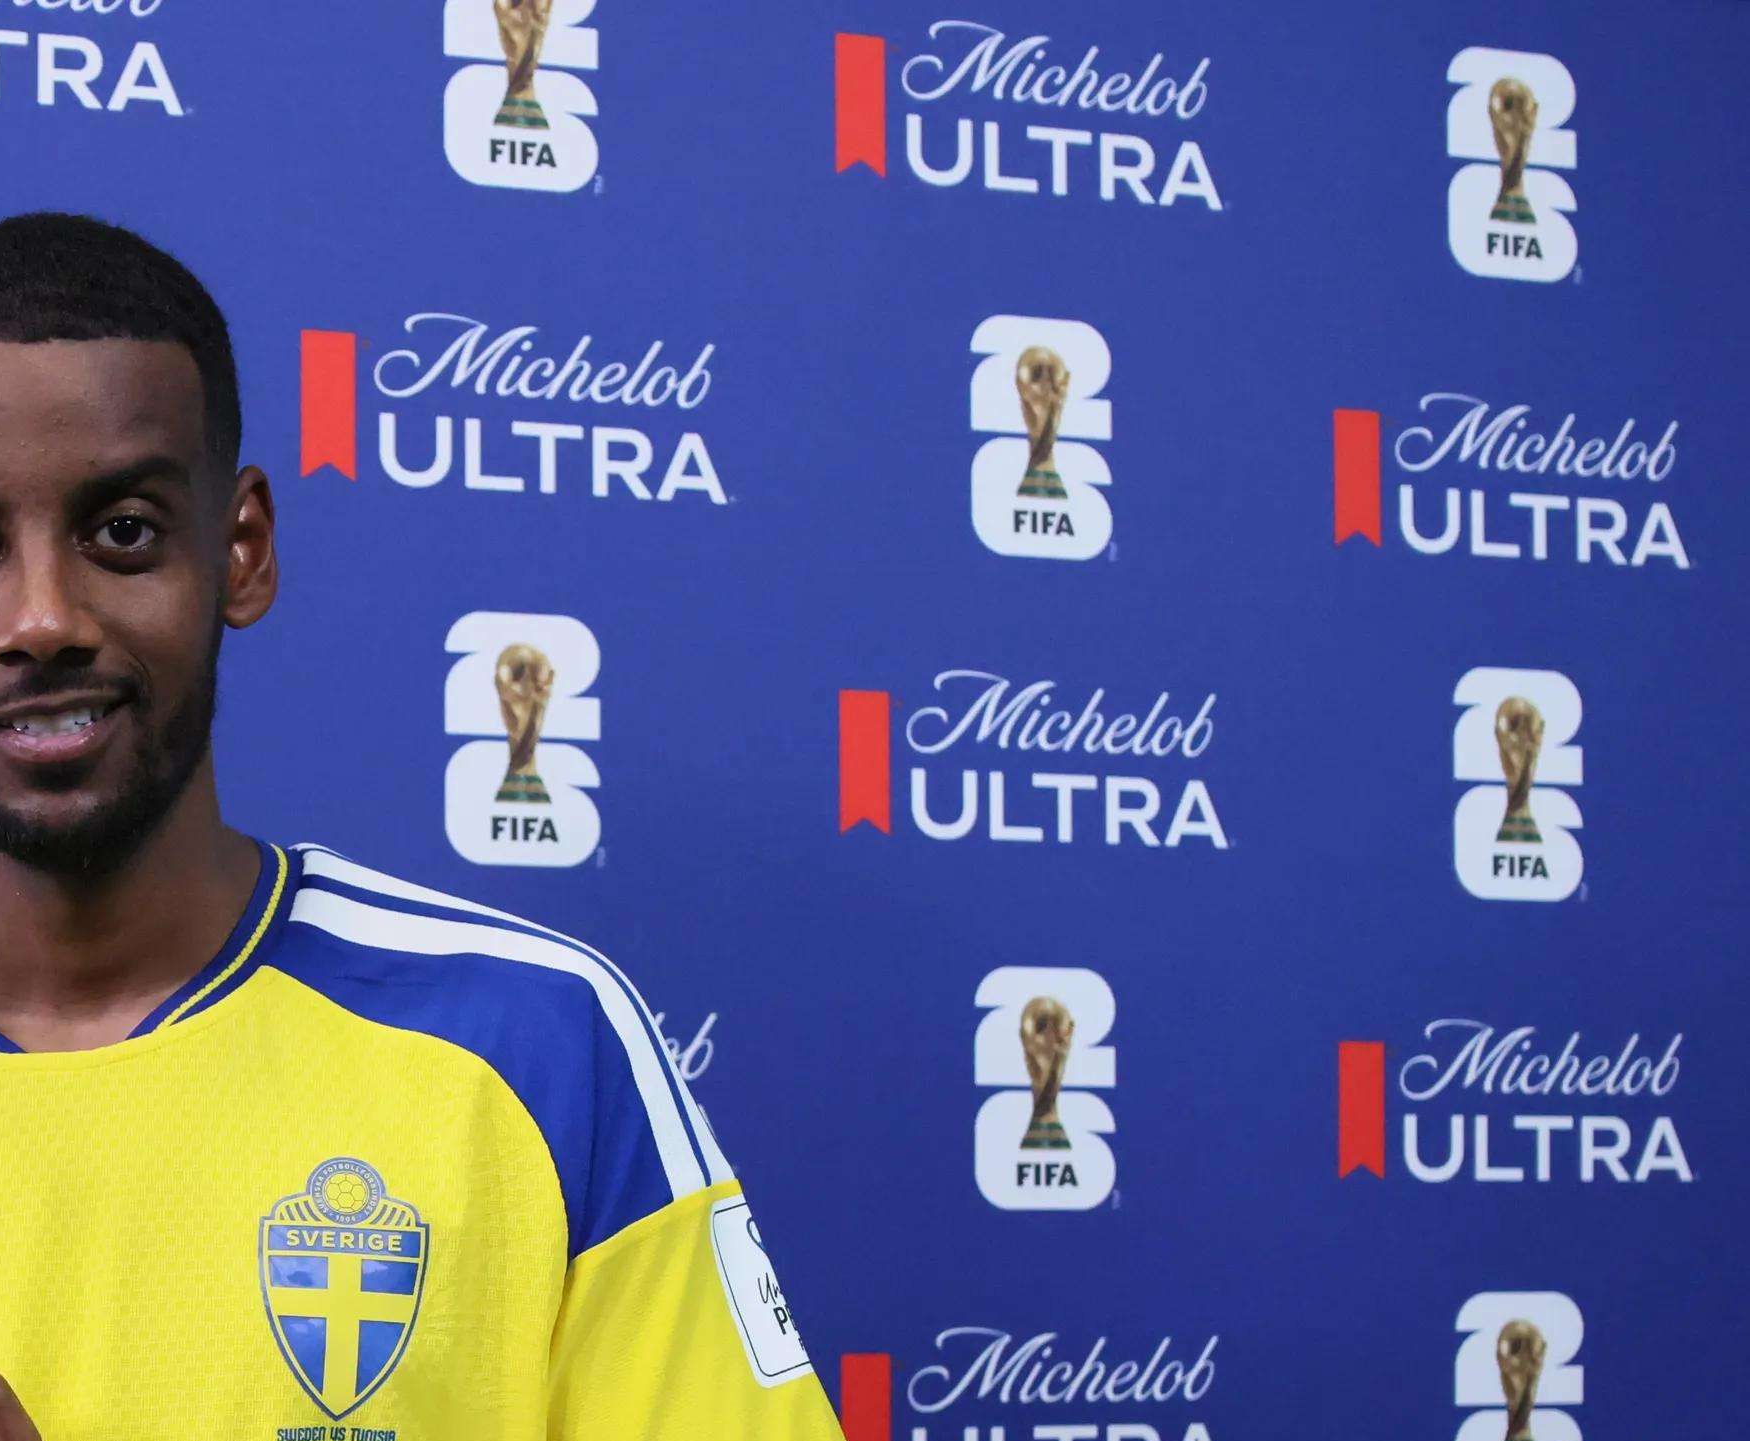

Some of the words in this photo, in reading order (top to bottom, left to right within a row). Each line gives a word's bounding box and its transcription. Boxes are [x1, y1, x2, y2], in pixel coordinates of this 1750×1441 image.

[902, 20, 1210, 119] Michelob
[490, 138, 557, 168] FIFA
[906, 113, 1222, 210] ULTRA
[1487, 232, 1543, 259] FIFA
[374, 313, 714, 408] Michelob
[379, 412, 727, 504] ULTRA
[1395, 393, 1678, 481] Michelob
[1014, 510, 1075, 537] FIFA
[1400, 485, 1689, 569] ULTRA
[906, 670, 1215, 757] Michelob
[492, 816, 559, 843] FIFA
[911, 768, 1228, 848] ULTRA
[1493, 854, 1549, 879] FIFA
[1400, 1019, 1682, 1100] Michelob
[1017, 1163, 1078, 1187] FIFA
[1404, 1114, 1692, 1182] ULTRA
[286, 1229, 404, 1252] SVERIGE
[908, 1327, 1218, 1412] Michelob
